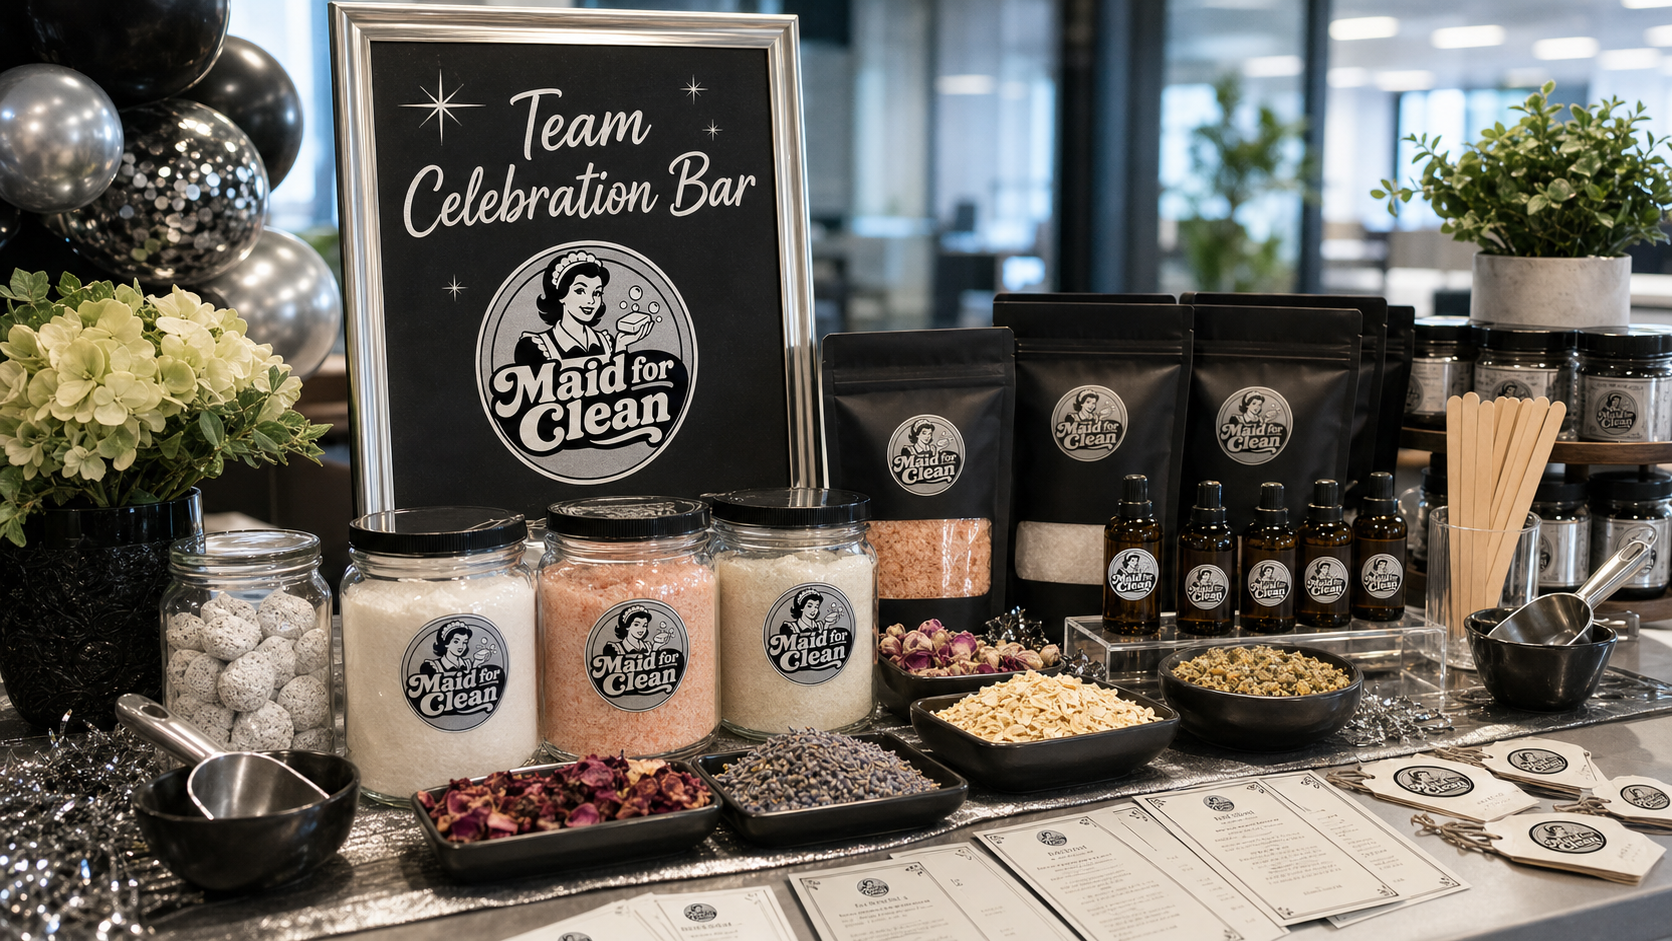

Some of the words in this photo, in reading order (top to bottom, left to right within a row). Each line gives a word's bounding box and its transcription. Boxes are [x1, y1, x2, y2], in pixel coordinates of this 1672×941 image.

[509, 88, 651, 161] Team
[403, 162, 659, 238] Celebration
[668, 151, 756, 217] Bar
[493, 352, 626, 418] Maid
[631, 356, 674, 384] for
[519, 391, 671, 451] Clean
[1056, 421, 1101, 438] Maid
[1102, 421, 1119, 431] for
[1220, 423, 1265, 440] Maid
[1267, 424, 1283, 434] for
[1064, 433, 1117, 450] Clean
[1227, 435, 1280, 452] Clean
[893, 453, 939, 472] Maid
[941, 452, 956, 464] for
[902, 465, 955, 484] Clean
[770, 629, 828, 656] Maid
[829, 630, 848, 642] for
[592, 651, 656, 678] Maid
[658, 652, 679, 666] for
[780, 646, 846, 672] Clean
[408, 670, 476, 698] Maid
[479, 668, 500, 684] for
[603, 668, 676, 696] Clean
[420, 686, 498, 716] Clean
